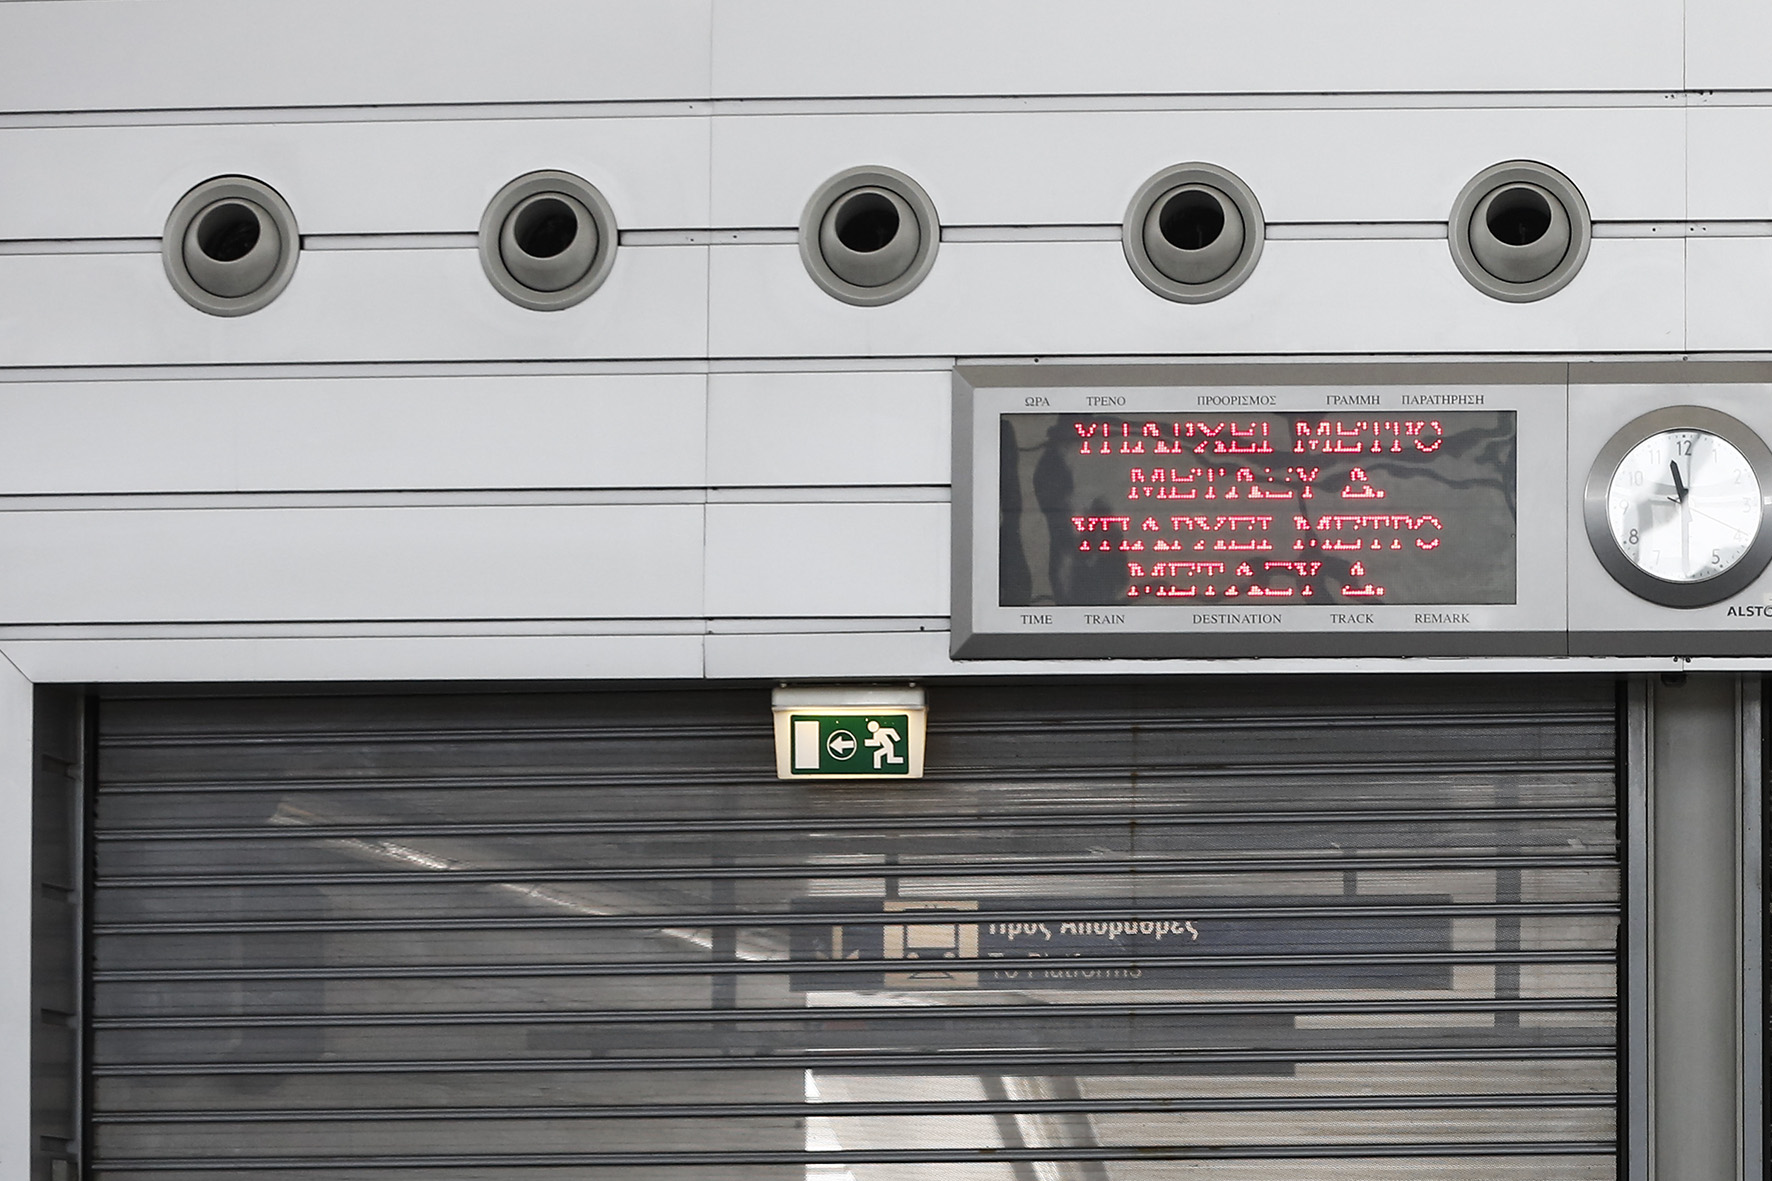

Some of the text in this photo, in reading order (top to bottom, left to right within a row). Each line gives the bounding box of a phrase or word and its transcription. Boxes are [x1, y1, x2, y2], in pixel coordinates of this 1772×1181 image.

[1024, 394, 1484, 407] ΩΡΑ ΤΡΕΝΟ ΠΡΟΟΡΙΣΜΟΣ ΓΡΑΜΜΗ ΠΑΡΑΤΗΡΗΣΗ
[1676, 441, 1692, 456] 12
[1628, 528, 1640, 545] 8
[1711, 548, 1721, 564] 5
[1020, 613, 1470, 625] TIME TRAIN DESTINATION TRACK REMARK
